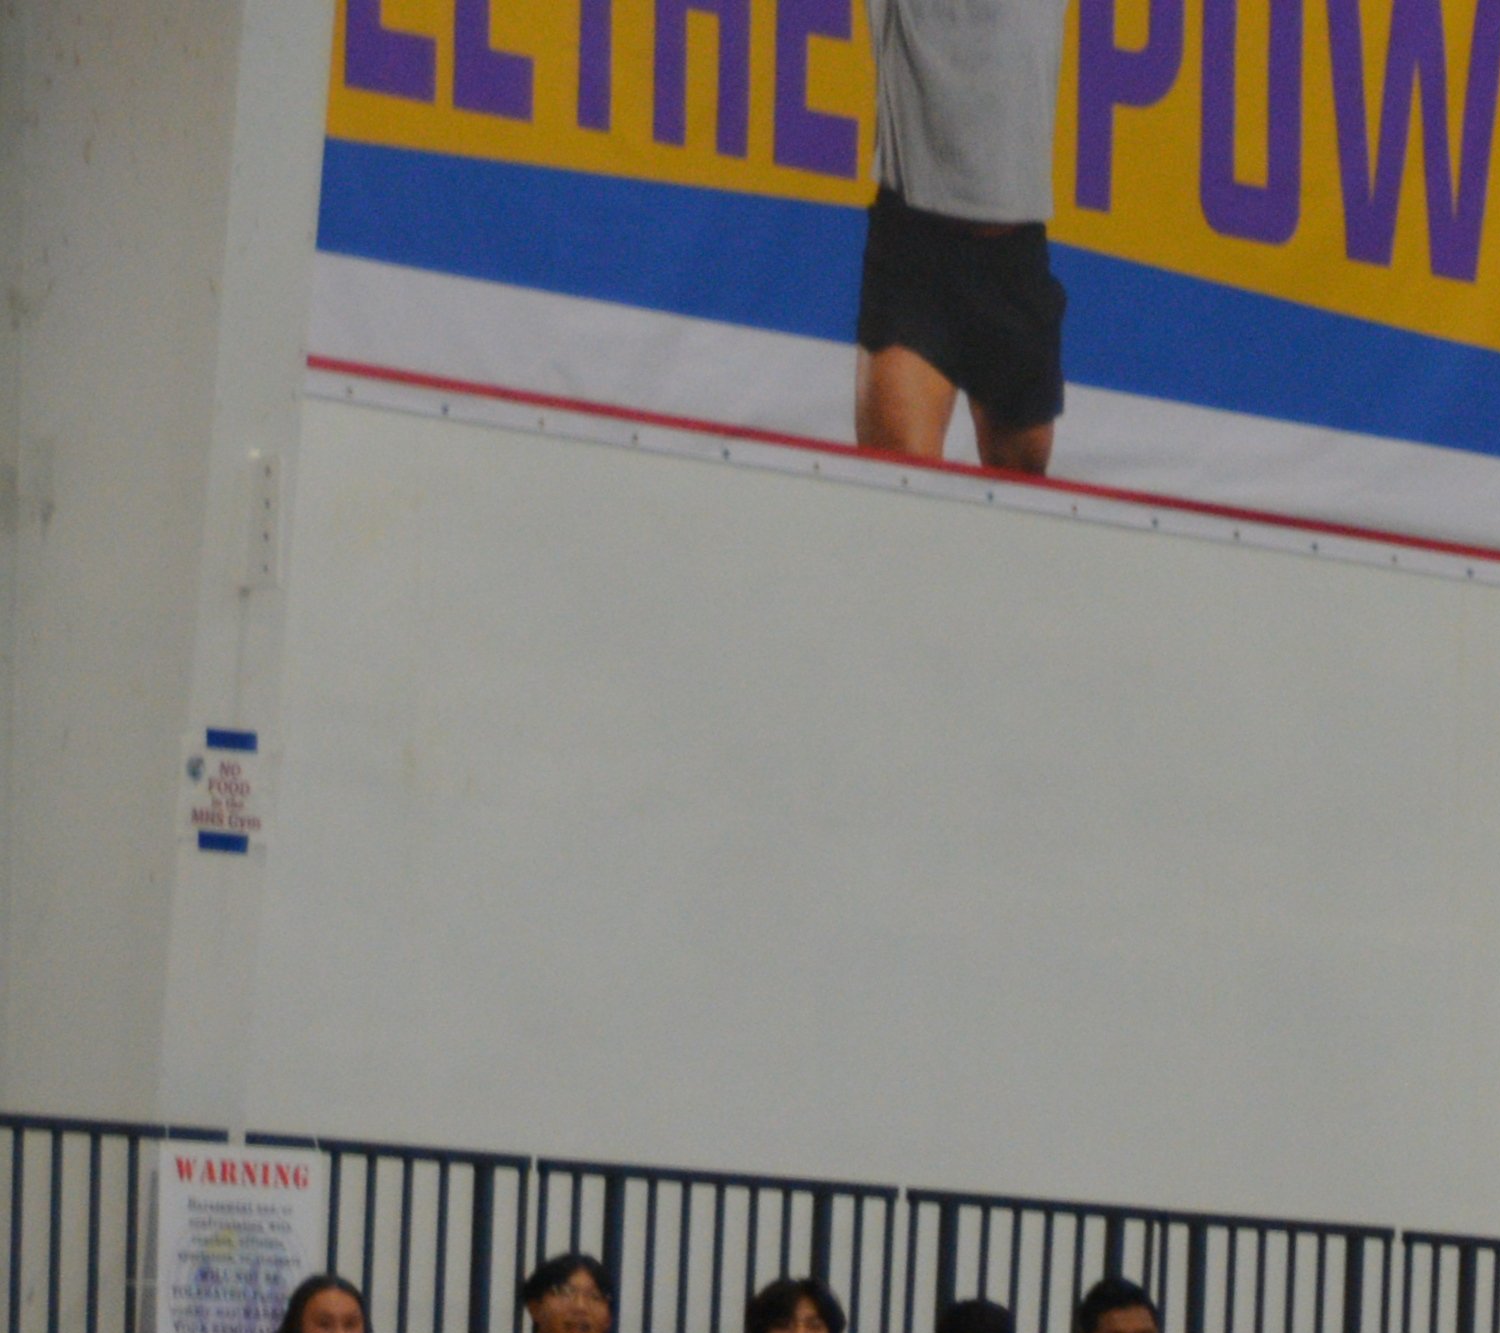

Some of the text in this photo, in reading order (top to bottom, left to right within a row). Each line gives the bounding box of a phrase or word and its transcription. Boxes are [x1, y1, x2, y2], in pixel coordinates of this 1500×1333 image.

[219, 761, 242, 778] NO
[208, 778, 251, 797] FOOD
[176, 1155, 310, 1190] WARNING
